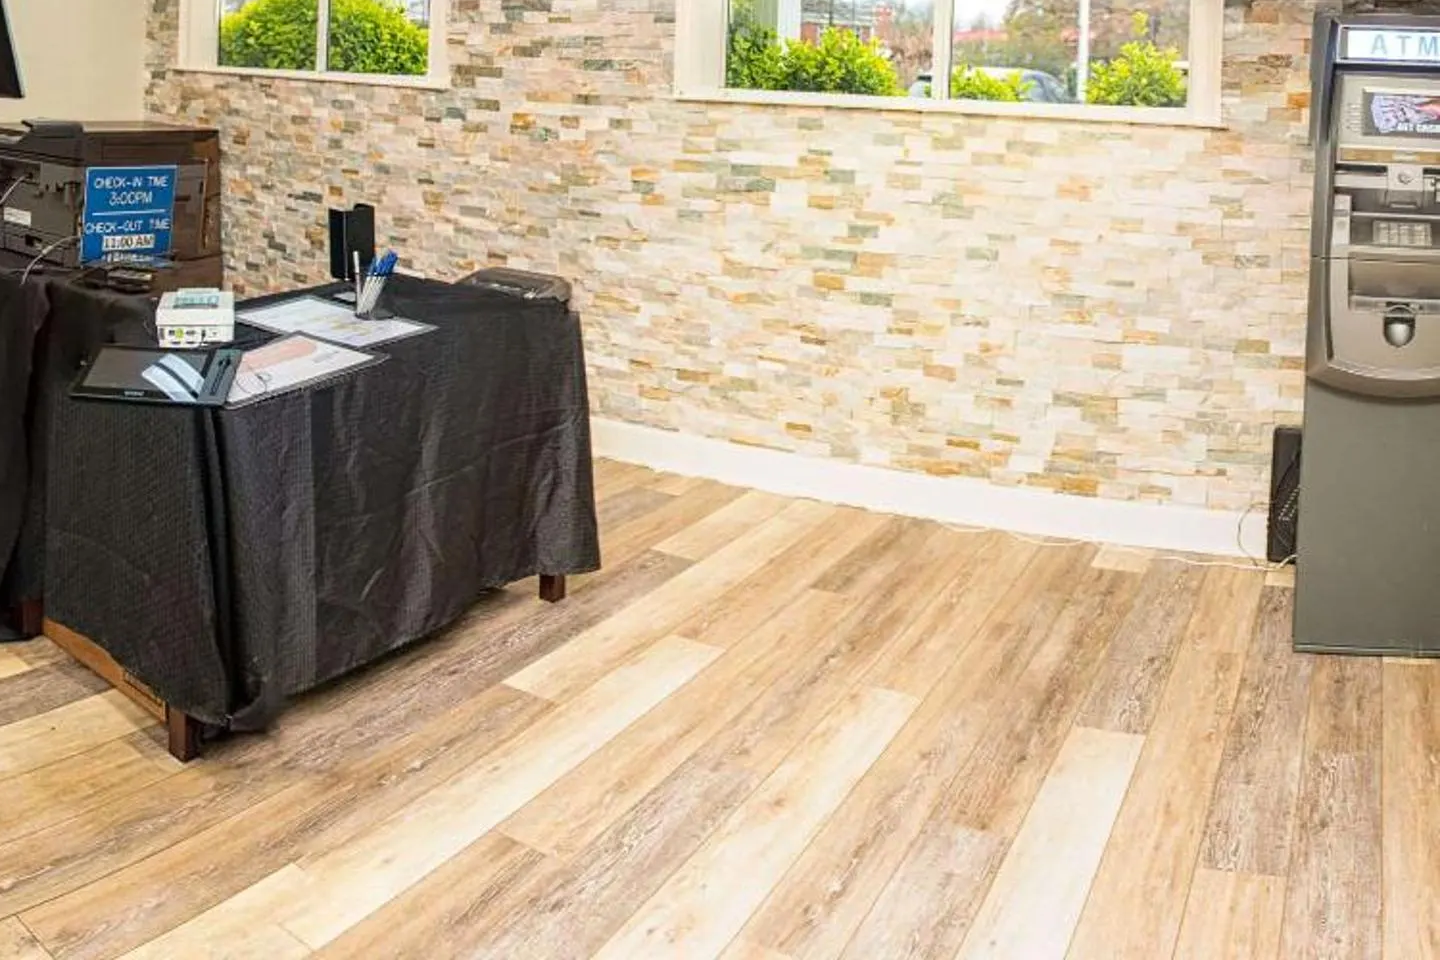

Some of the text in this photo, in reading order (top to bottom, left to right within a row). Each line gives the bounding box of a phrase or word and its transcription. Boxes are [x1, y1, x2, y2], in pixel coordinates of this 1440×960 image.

[1371, 34, 1440, 56] ATM
[94, 175, 144, 189] CHECK-IN
[85, 220, 144, 234] CHECK-OUT
